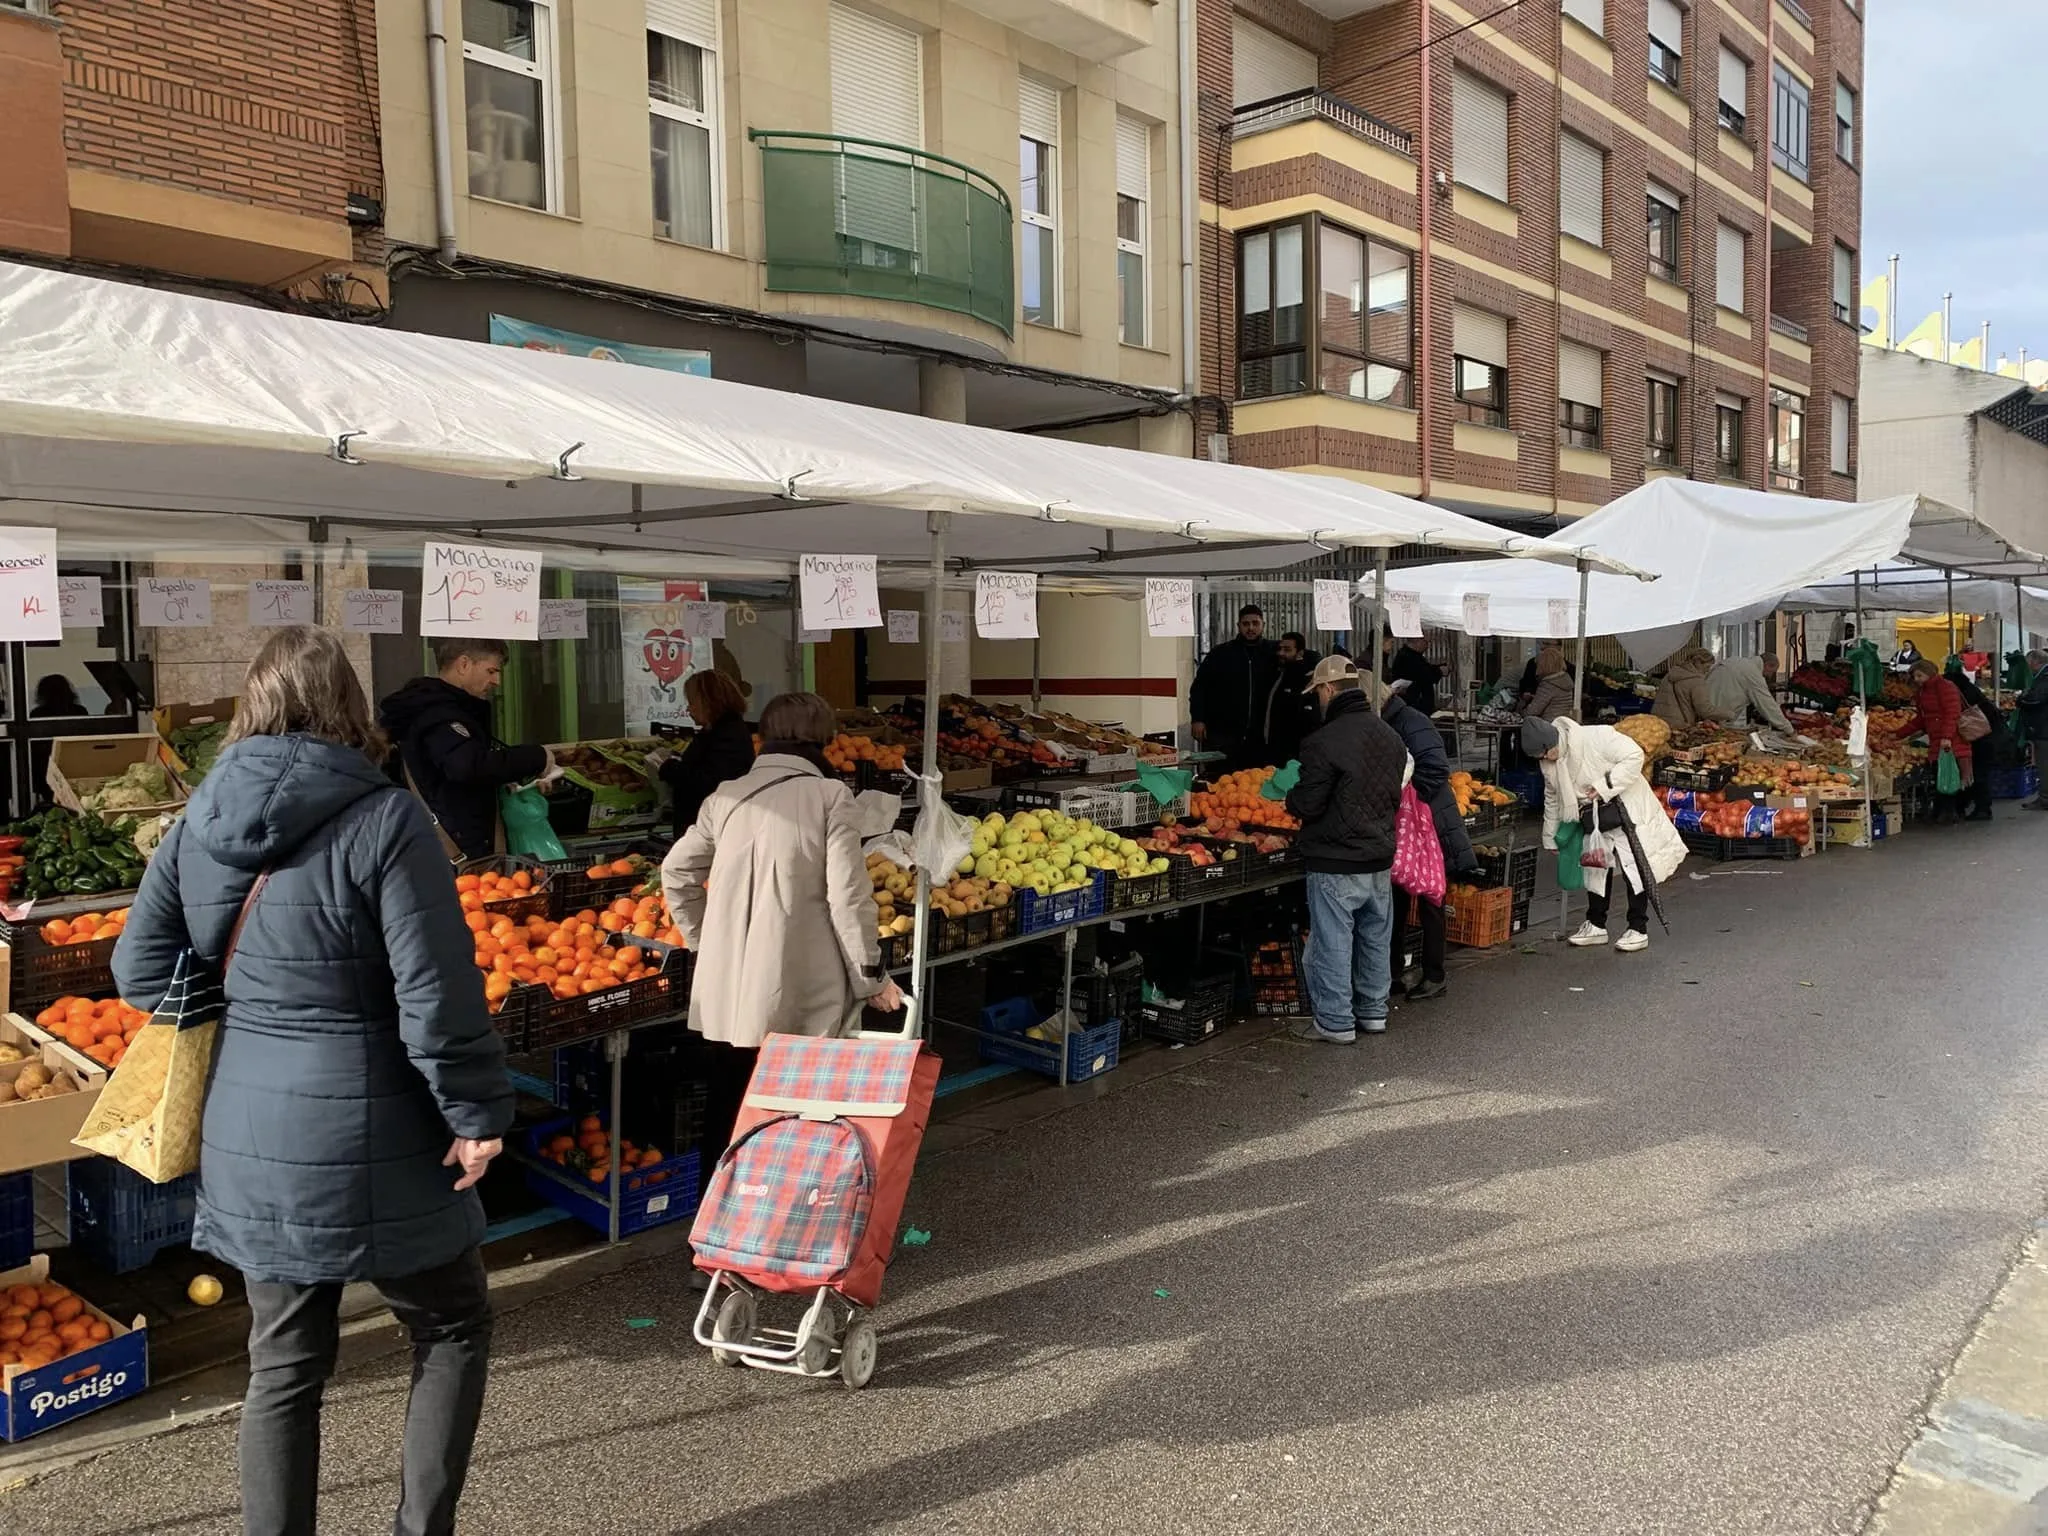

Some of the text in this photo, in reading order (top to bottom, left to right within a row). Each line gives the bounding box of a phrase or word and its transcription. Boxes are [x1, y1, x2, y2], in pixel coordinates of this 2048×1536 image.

[435, 547, 535, 573] Mandarina
[804, 556, 874, 577] Mandarina
[980, 574, 1035, 590] Manzana
[1147, 580, 1190, 594] Manzana
[23, 595, 48, 618] KL
[514, 609, 532, 624] KL
[30, 1371, 127, 1418] Postigo
